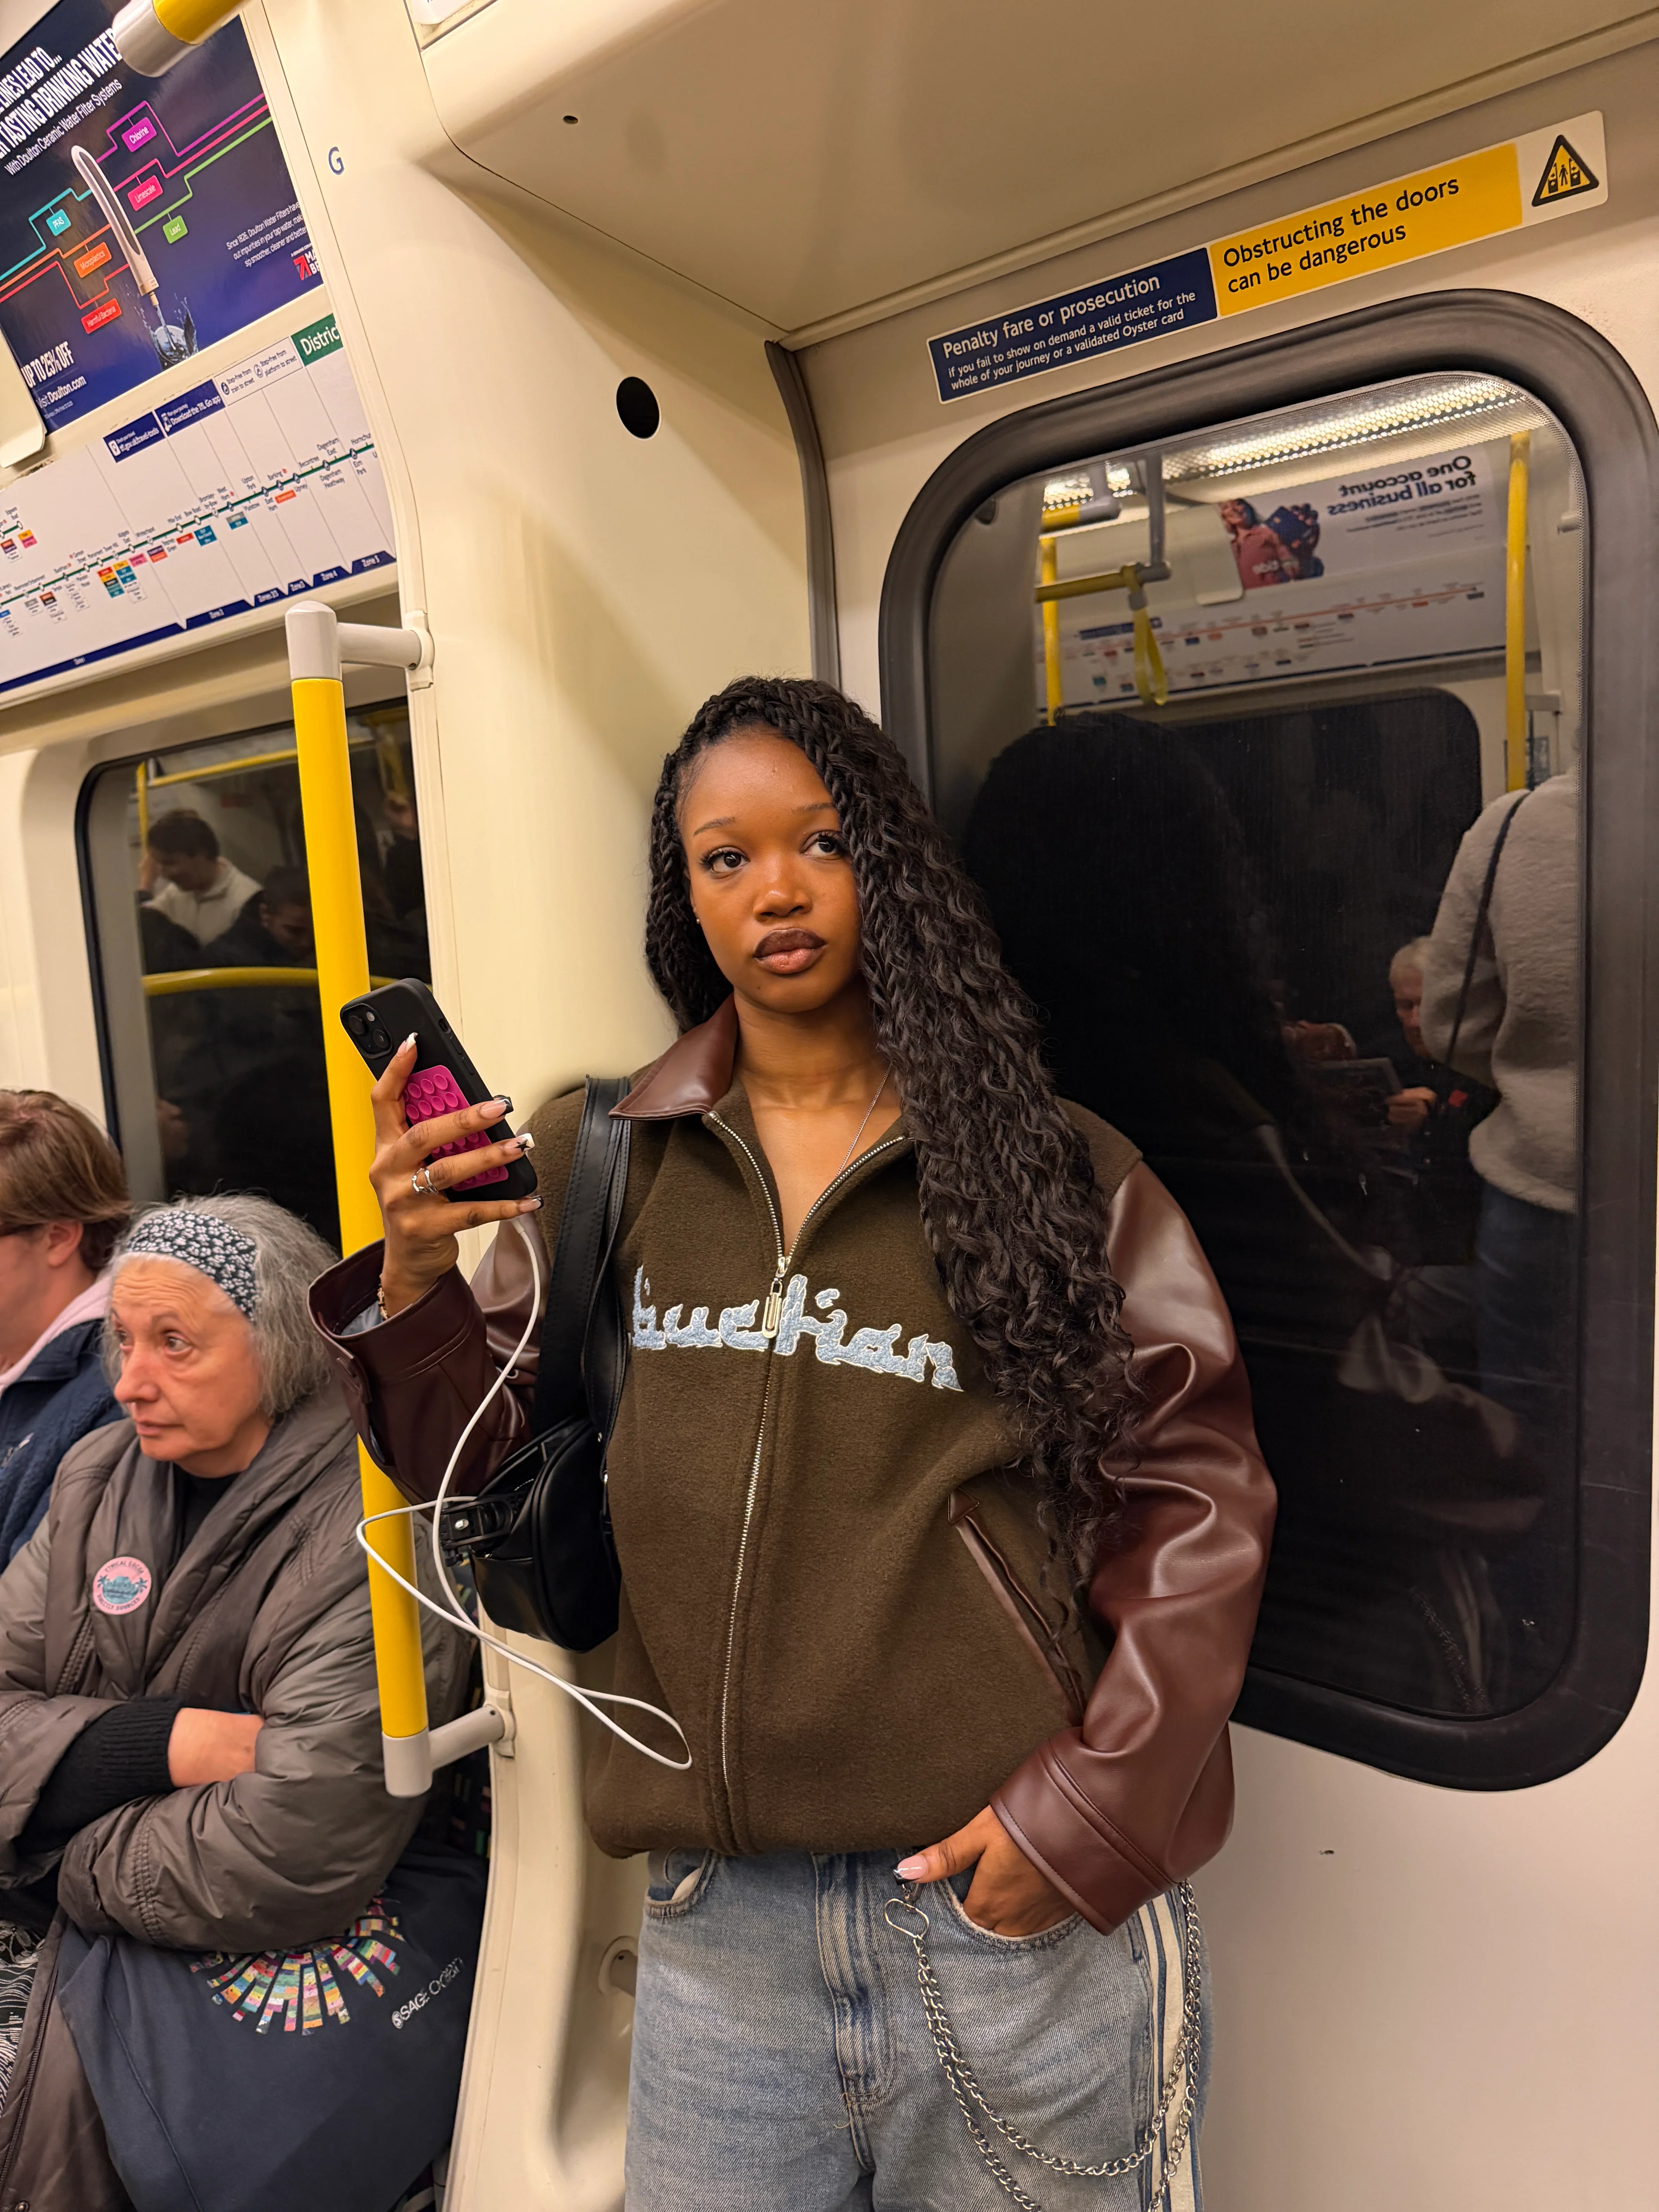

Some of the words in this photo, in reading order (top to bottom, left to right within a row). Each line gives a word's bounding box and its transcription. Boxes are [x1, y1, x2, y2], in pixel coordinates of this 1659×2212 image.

[0, 74, 25, 108] LINES
[15, 57, 44, 90] LEAD
[31, 47, 62, 72] TO...
[0, 99, 47, 148] TASTING
[31, 58, 94, 118] DRINKING
[4, 159, 22, 175] With
[17, 144, 43, 166] Doulton
[37, 124, 64, 149] Ceramic
[58, 113, 81, 132] Water
[76, 99, 96, 119] Filter
[91, 79, 122, 107] Systems
[129, 126, 149, 144] Chlorine
[328, 146, 344, 175] G
[135, 184, 156, 203] Limescale
[53, 217, 64, 228] PFAS
[170, 223, 180, 235] Lead
[226, 240, 239, 250] Since
[247, 222, 265, 236] Doulton
[263, 216, 277, 227] Water
[276, 208, 290, 220] Filters
[288, 202, 300, 212] have
[1223, 216, 1344, 266] Obstructing
[1350, 202, 1388, 226] the
[1396, 179, 1459, 212] doors
[240, 237, 261, 256] impurities
[264, 232, 274, 244] your
[273, 227, 281, 237] tap
[270, 239, 285, 252] cleaner
[285, 232, 294, 242] and
[81, 250, 105, 270] Microplastics
[1228, 271, 1261, 293] can
[1267, 261, 1292, 281] be
[1300, 225, 1407, 271] dangerous
[943, 330, 998, 358] Penalty
[1003, 319, 1034, 338] fare
[1039, 311, 1054, 326] or
[1060, 276, 1160, 325] prosecution
[300, 325, 340, 355] Distric
[949, 367, 955, 378] if
[958, 363, 974, 377] you
[976, 356, 991, 369] fail
[993, 353, 1004, 363] to
[1007, 344, 1030, 359] show
[1034, 340, 1046, 350] on
[1048, 325, 1086, 346] demand
[1097, 314, 1121, 330] valid
[1124, 304, 1155, 322] ticket
[1157, 299, 1173, 311] for
[1176, 292, 1196, 305] the
[951, 376, 978, 390] whole
[981, 371, 990, 381] of
[993, 364, 1013, 380] your
[1016, 352, 1051, 373] journey
[1053, 349, 1063, 359] or
[1075, 329, 1120, 352] validated
[1123, 318, 1158, 337] Oyster
[1161, 309, 1184, 325] card
[21, 364, 36, 388] UP
[30, 359, 46, 382] TO
[40, 349, 62, 378] 25%
[55, 341, 74, 368] OFF
[47, 376, 87, 403] Doulton.com
[204, 399, 213, 407] Go
[212, 396, 221, 405] app
